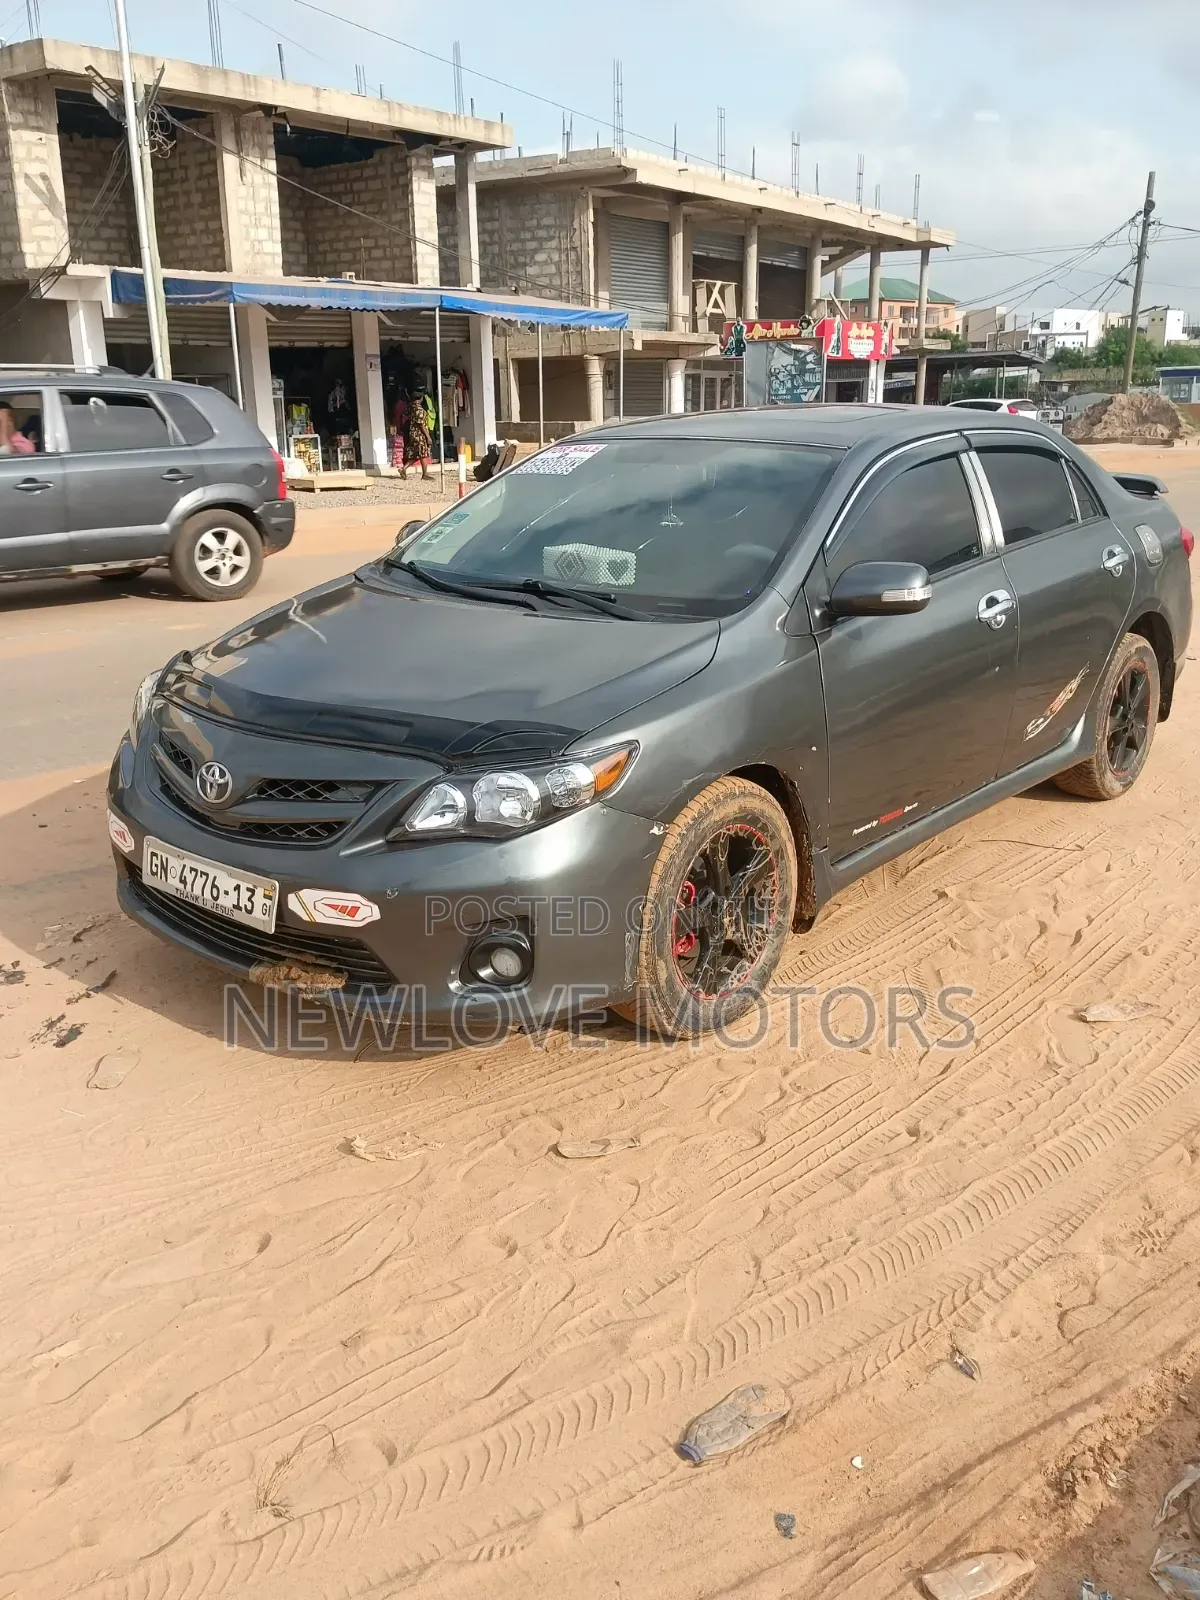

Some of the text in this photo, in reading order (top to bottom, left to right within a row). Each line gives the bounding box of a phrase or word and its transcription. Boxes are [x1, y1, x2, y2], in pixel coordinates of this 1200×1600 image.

[149, 851, 169, 882] GN
[179, 864, 256, 915] 4776-13
[175, 887, 235, 917] THANK U JESUS
